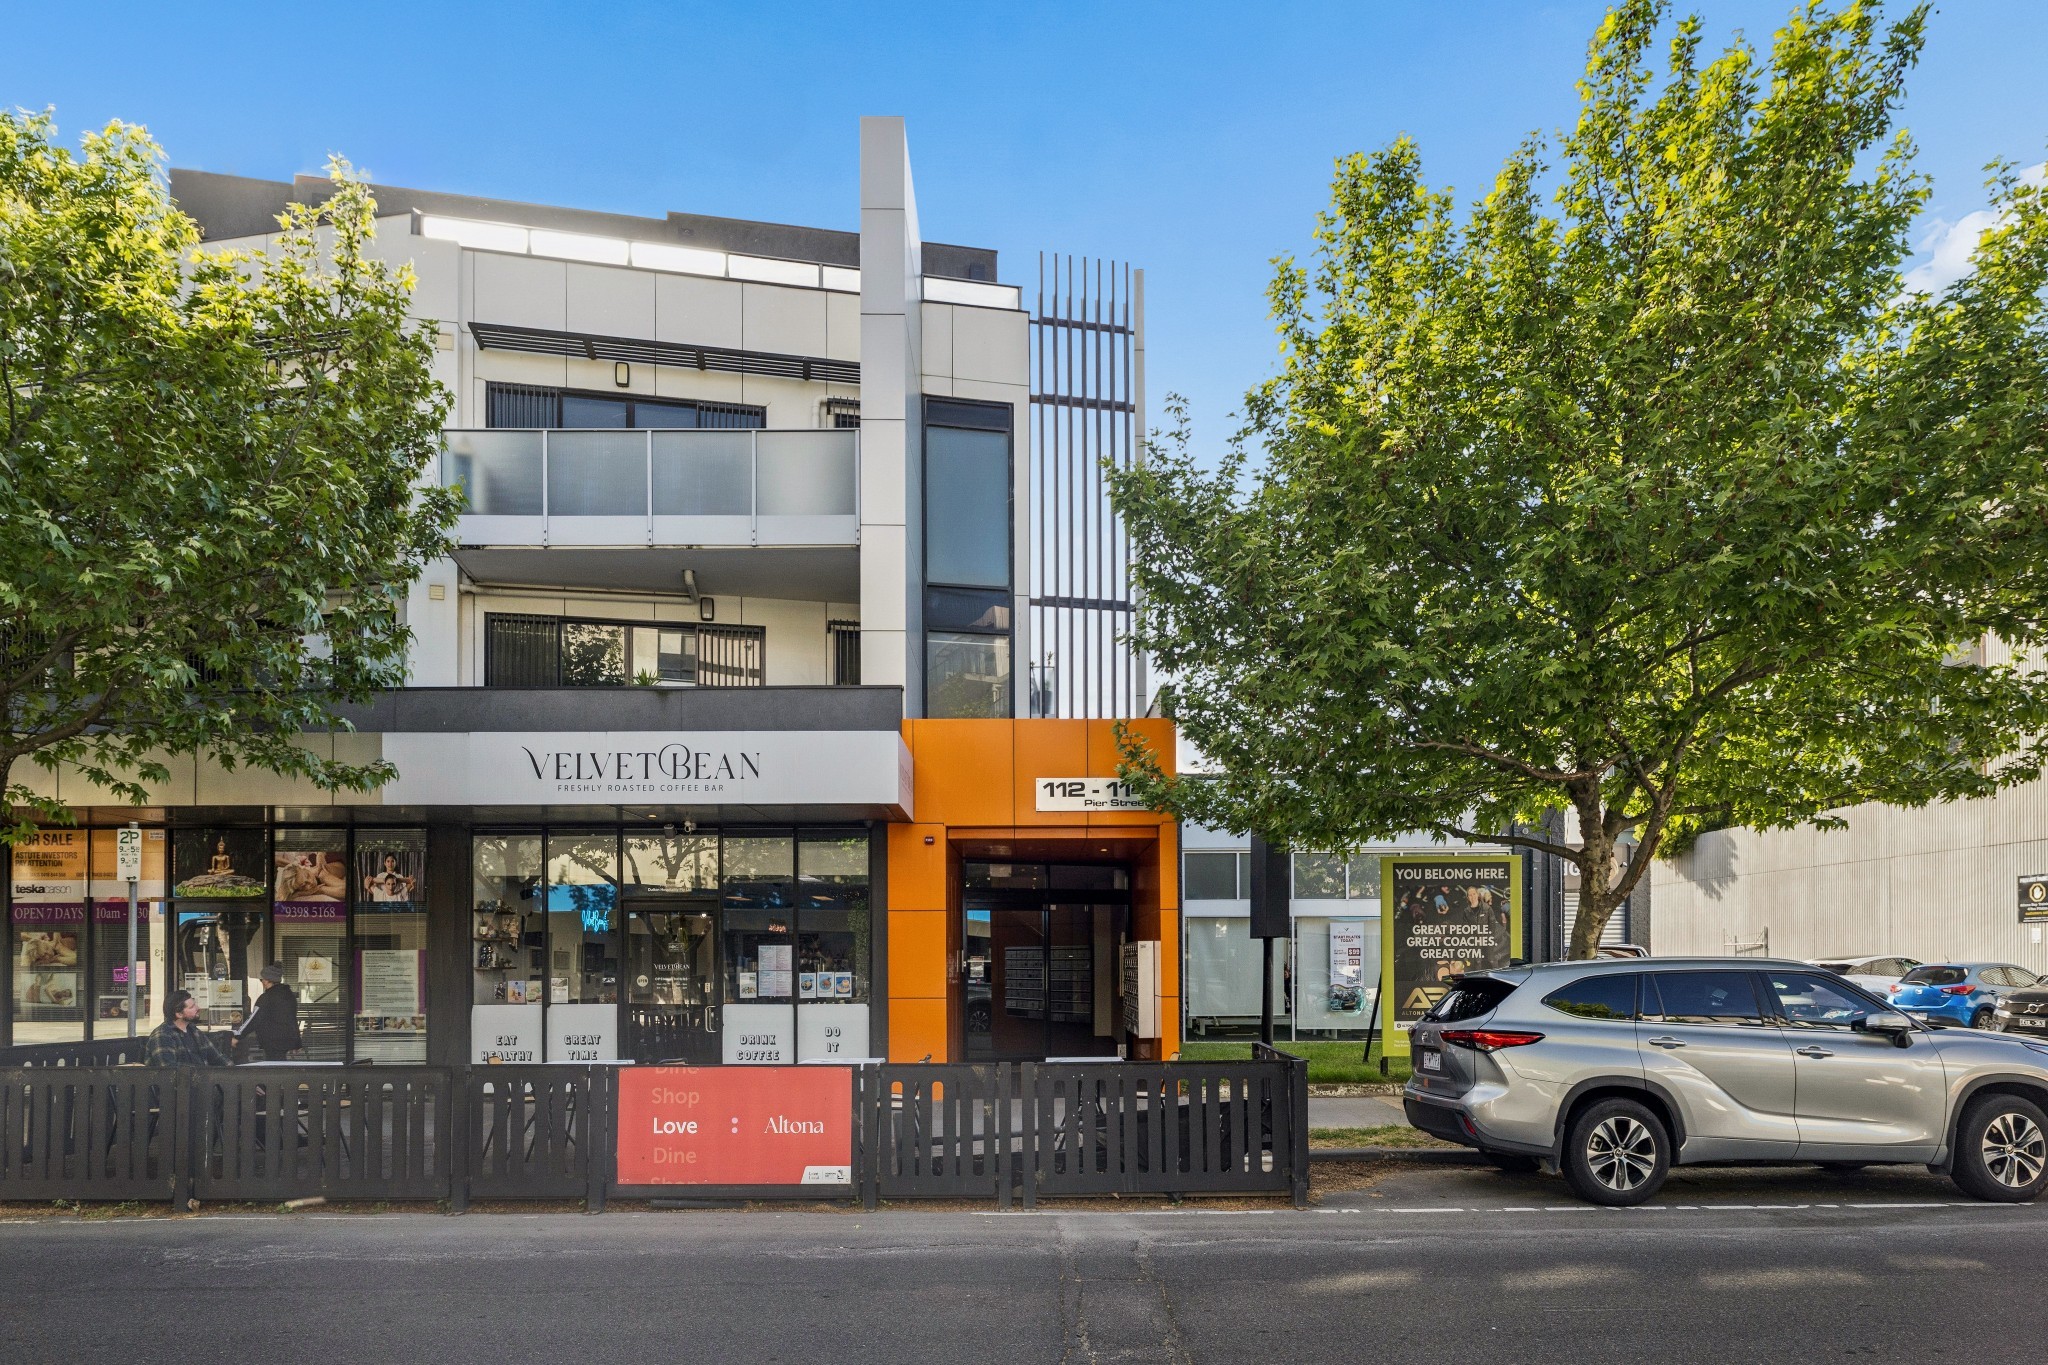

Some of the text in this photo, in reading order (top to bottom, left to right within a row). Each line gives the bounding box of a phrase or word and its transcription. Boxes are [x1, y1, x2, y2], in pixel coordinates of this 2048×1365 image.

[521, 743, 761, 780] VELVET BEAN
[557, 784, 725, 792] FRESHLY ROASTED COFFEE BAR
[1043, 781, 1086, 798] 112
[1084, 799, 1107, 807] Pier
[43, 833, 73, 846] SALE
[120, 831, 140, 844] 2P
[15, 851, 78, 859] ASTUTE INVESTORS
[1395, 868, 1508, 880] YOU BELONG HERE.
[14, 907, 84, 919] OPEN 7 DAYS
[96, 907, 121, 919] 10am
[285, 906, 336, 918] 9398 5168
[1412, 924, 1492, 935] GREAT PEOPLE.
[1406, 937, 1498, 947] GREAT COACHES.
[1420, 949, 1485, 959] GREAT GYM.
[824, 1026, 841, 1037] DO
[495, 1035, 518, 1046] EAT
[564, 1034, 601, 1045] GREAT
[739, 1034, 776, 1046] DRINK
[826, 1042, 840, 1053] IT
[567, 1050, 598, 1061] TIME
[736, 1050, 780, 1061] COFFEE
[651, 1087, 700, 1109] Shop
[653, 1117, 698, 1134] Love
[764, 1114, 824, 1134] Altona
[653, 1147, 697, 1164] Dine
